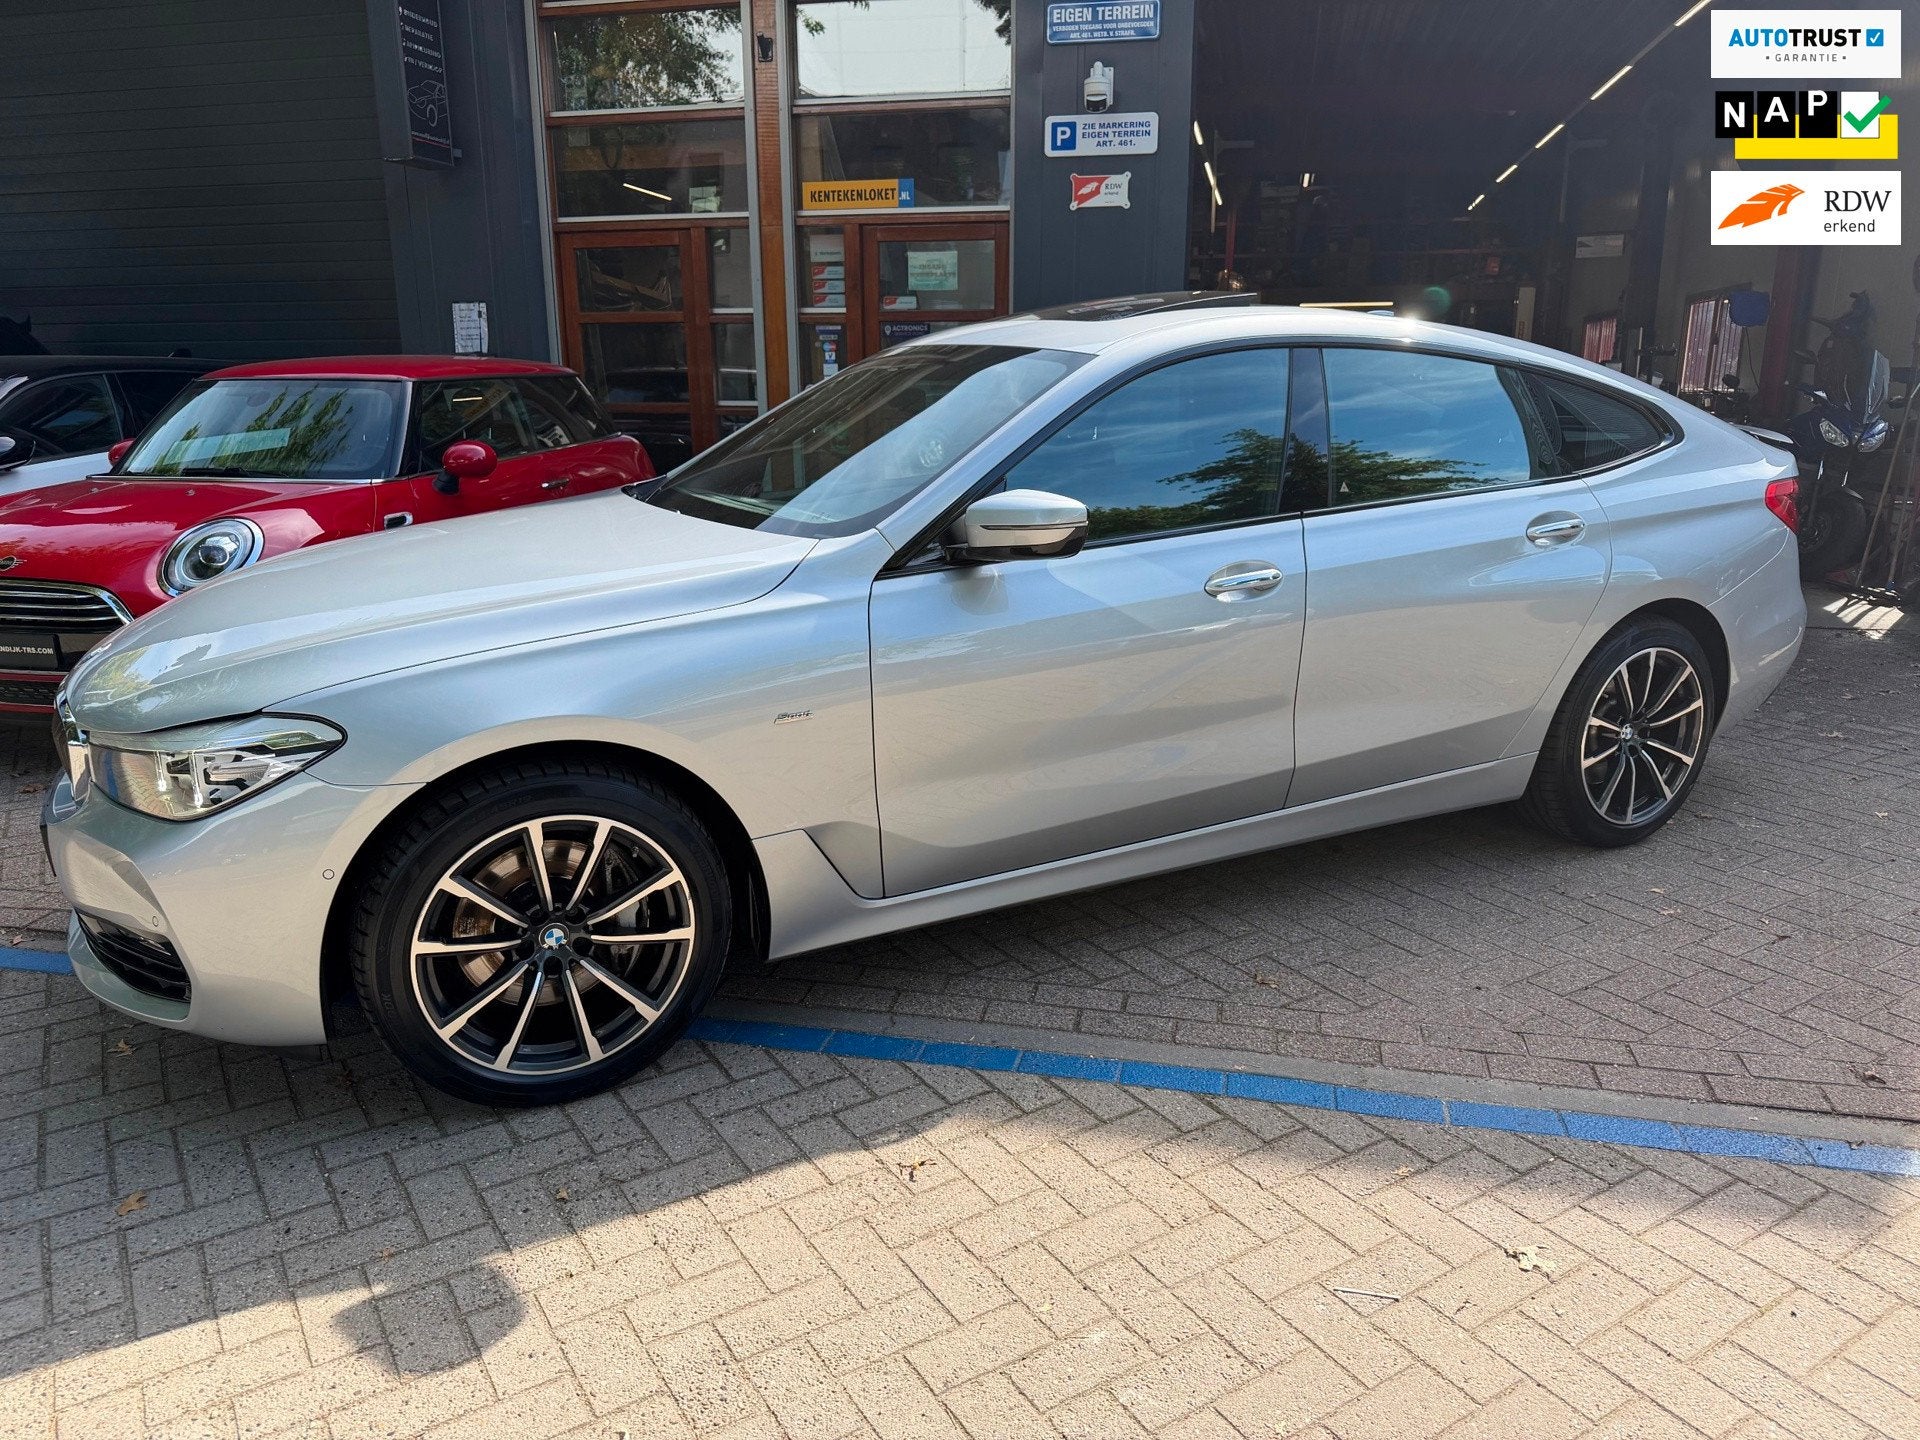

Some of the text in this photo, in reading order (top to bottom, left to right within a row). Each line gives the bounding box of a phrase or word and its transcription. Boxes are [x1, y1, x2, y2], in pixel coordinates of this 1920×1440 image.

[1053, 4, 1154, 23] EIGEN TERREIN
[1080, 23, 1103, 31] TOEGANG
[1081, 120, 1151, 131] ZIE MARKERING
[1056, 126, 1071, 147] P
[1081, 129, 1151, 139] EIGEN TERREIN
[1096, 138, 1136, 147] ART. 461.
[1104, 182, 1123, 190] RDW
[892, 324, 928, 332] ACTRONICS
